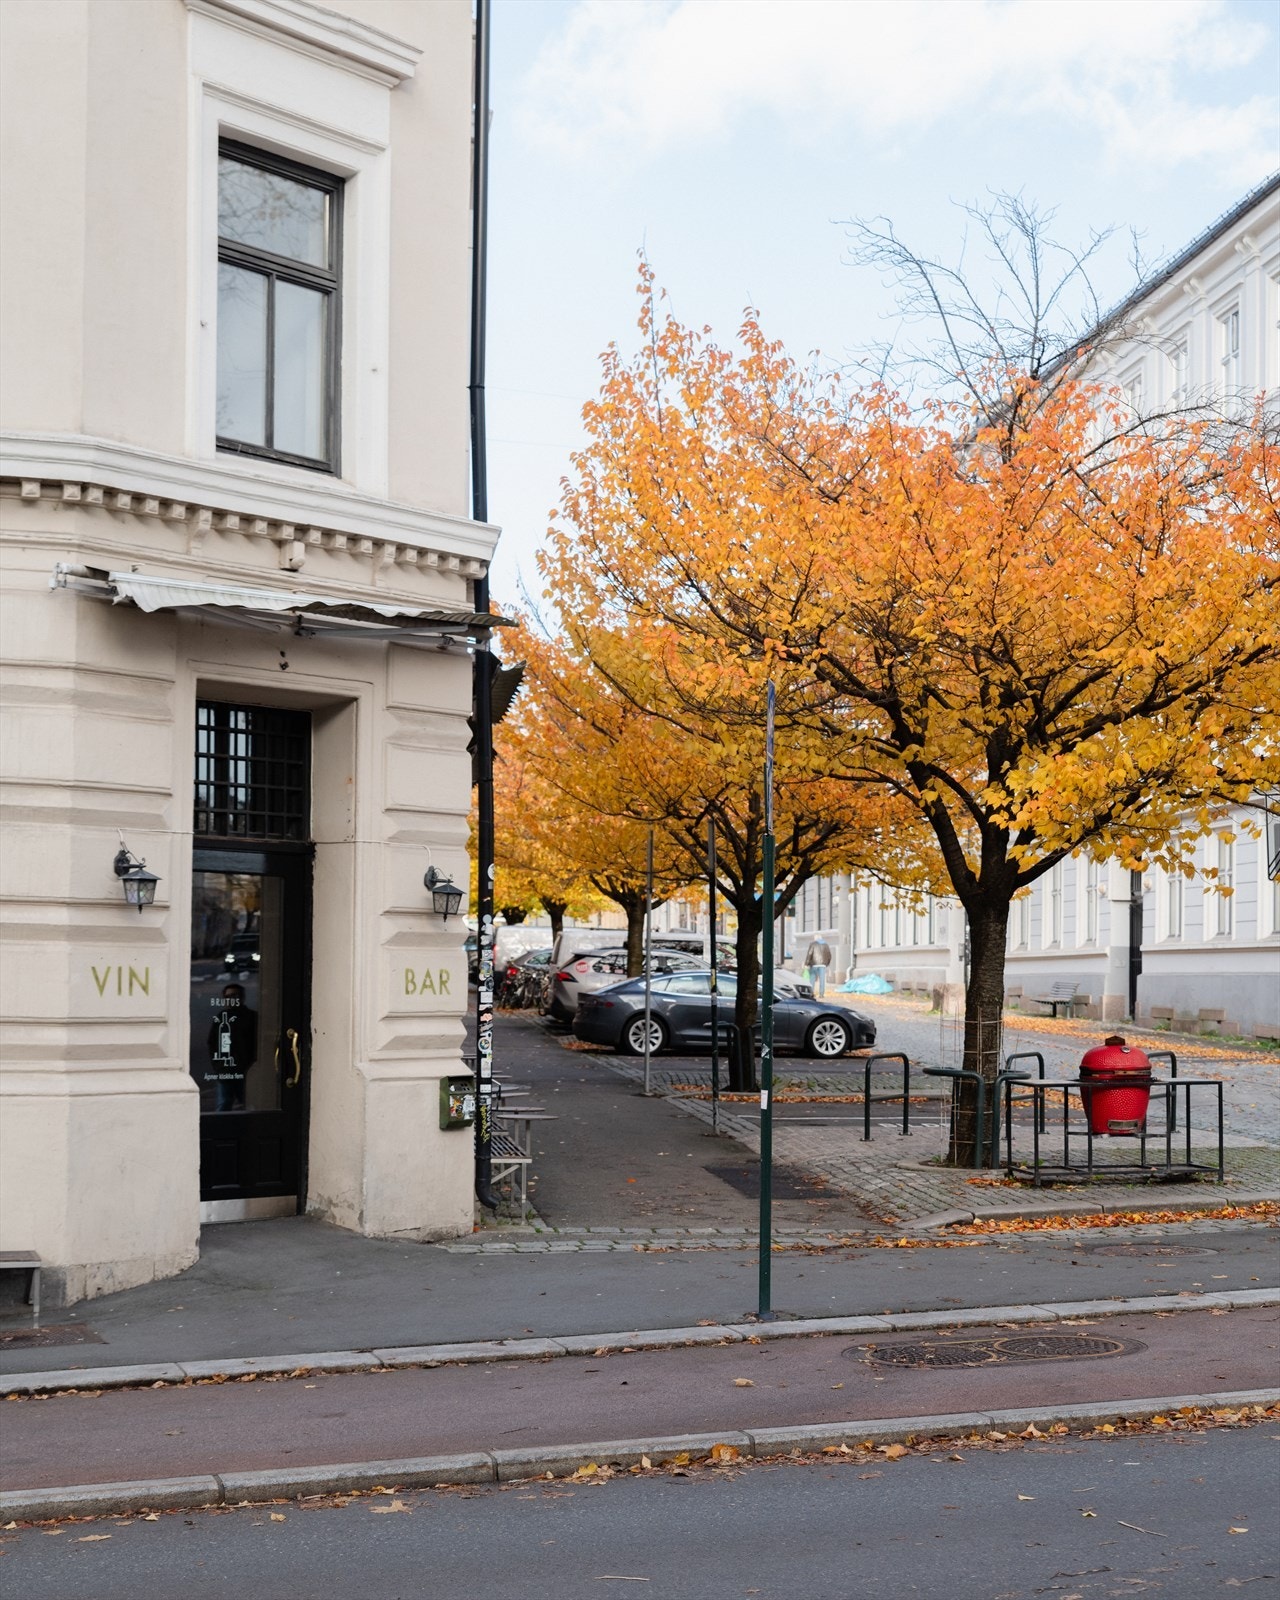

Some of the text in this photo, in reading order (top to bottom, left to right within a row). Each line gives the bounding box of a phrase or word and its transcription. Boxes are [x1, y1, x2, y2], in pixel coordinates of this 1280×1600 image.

[91, 966, 150, 997] VIN
[405, 968, 451, 995] BAR
[210, 998, 240, 1007] BRUTUS
